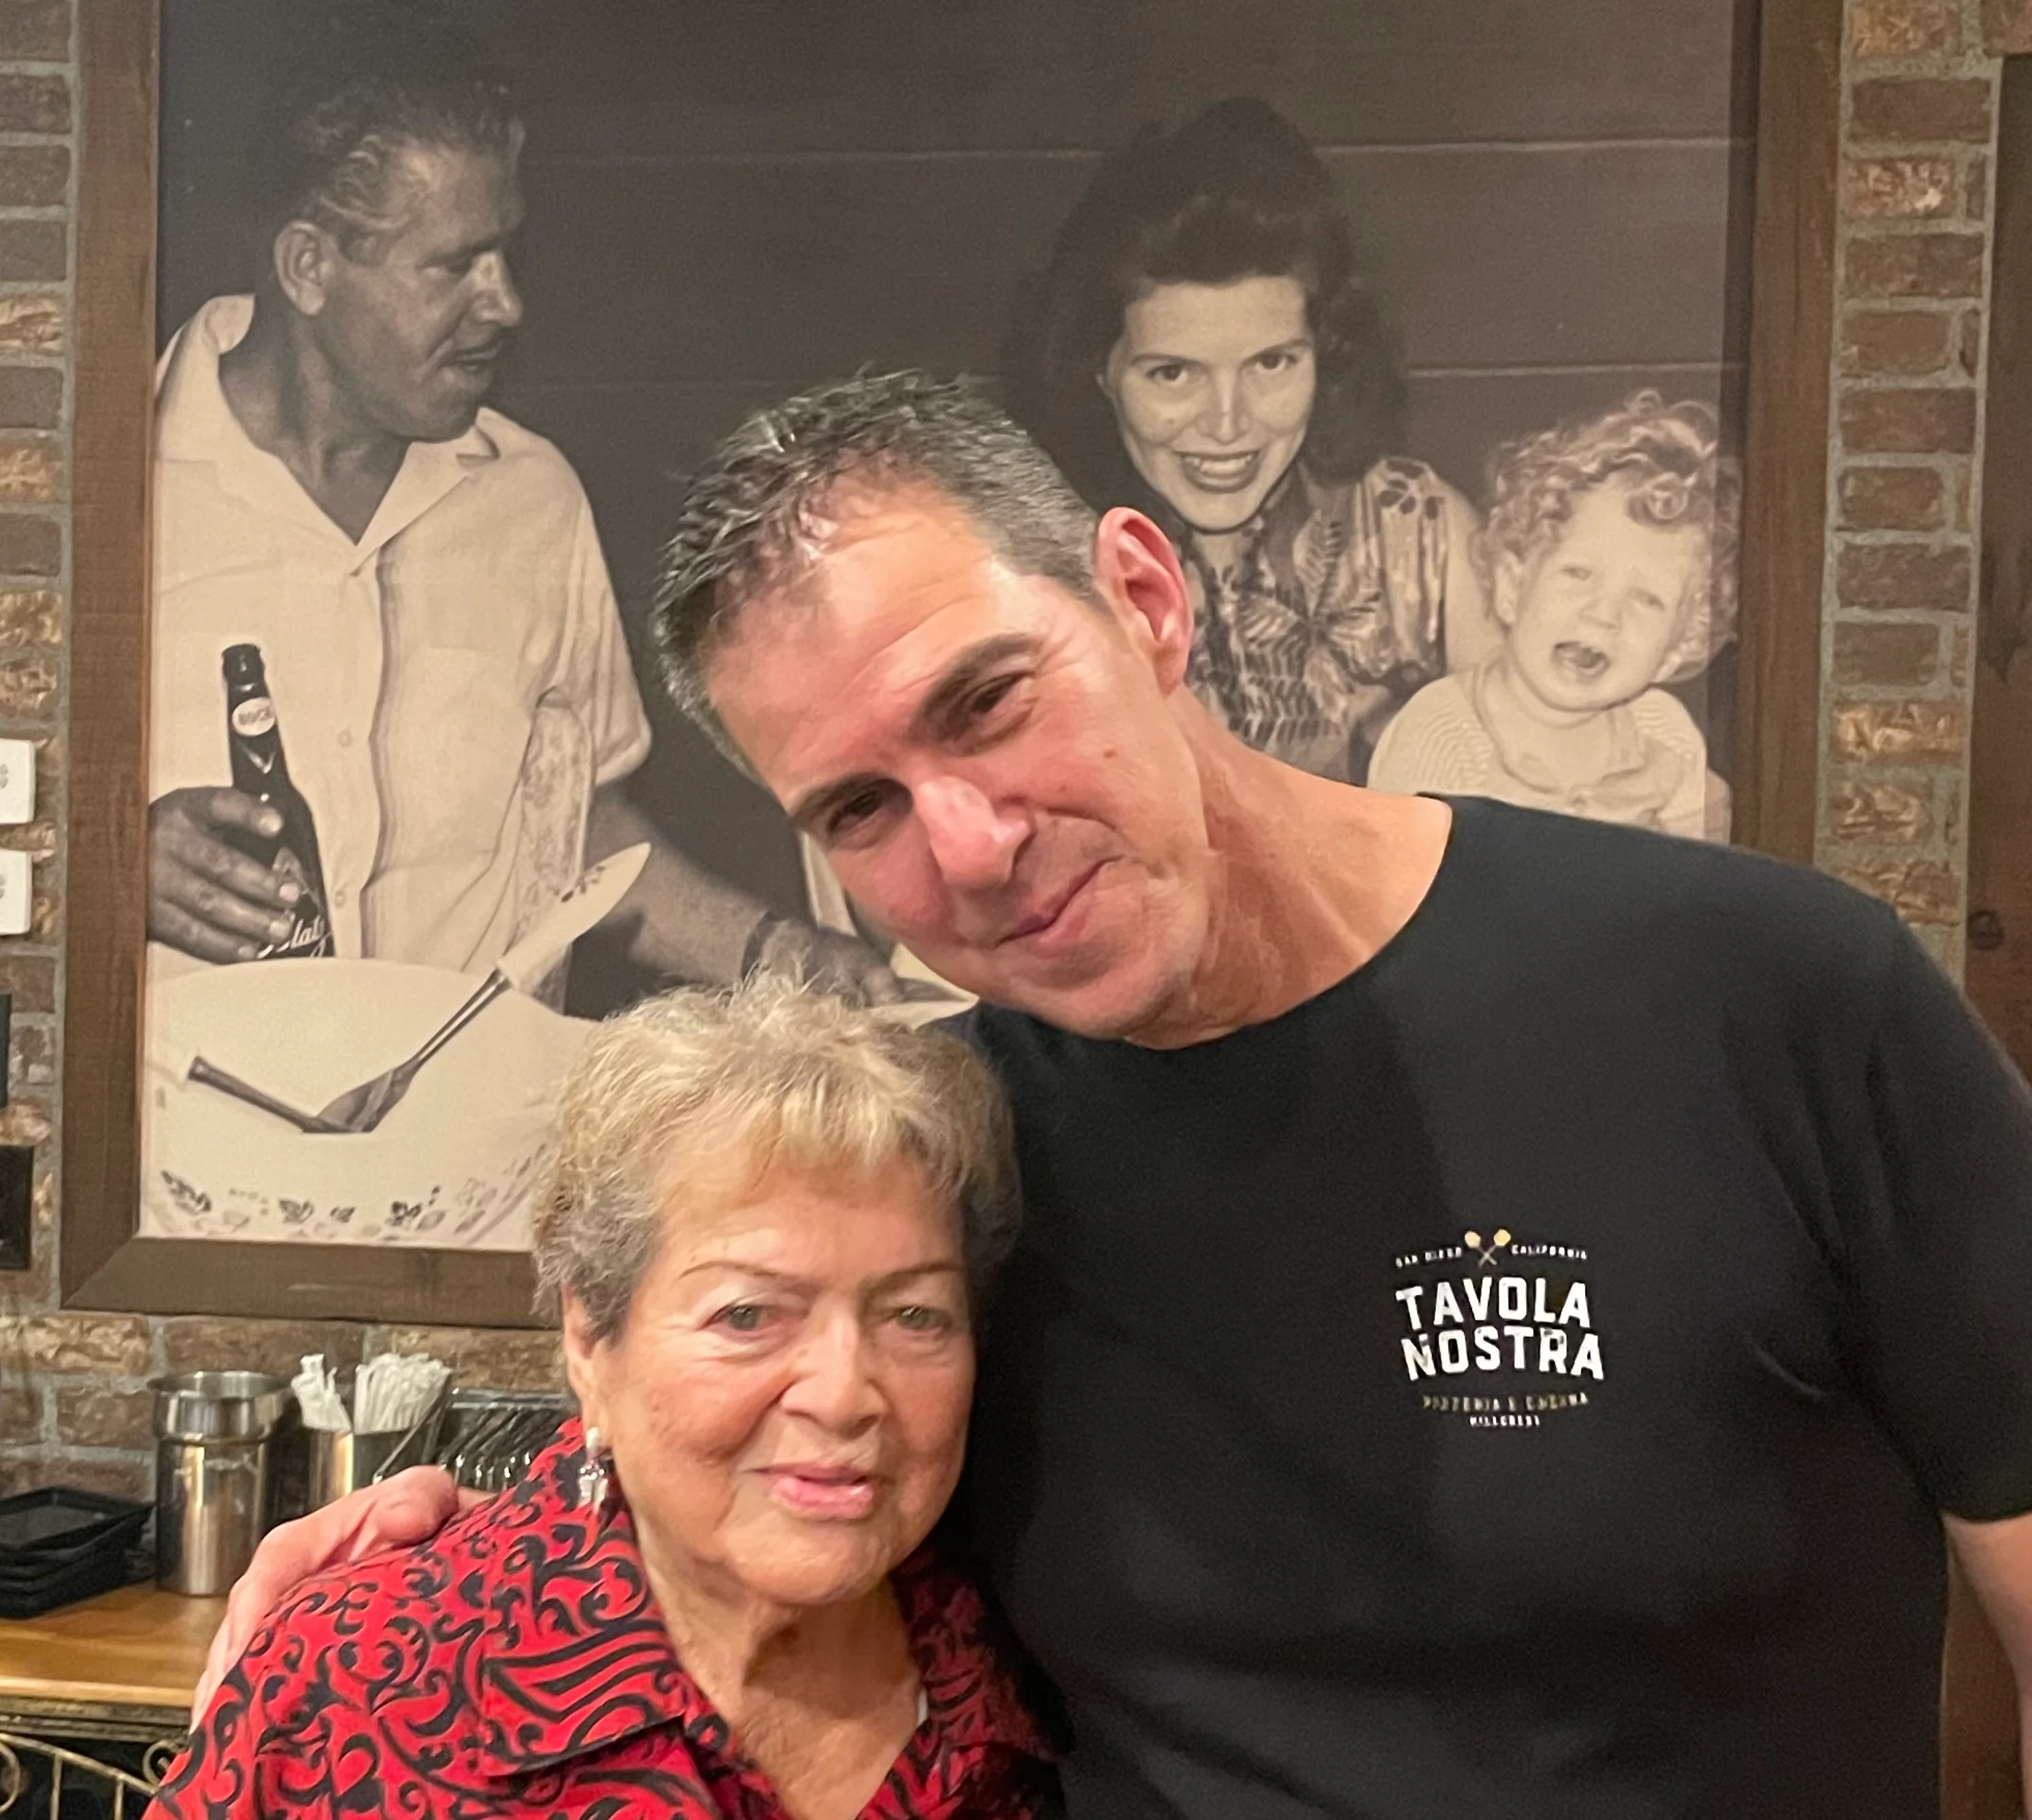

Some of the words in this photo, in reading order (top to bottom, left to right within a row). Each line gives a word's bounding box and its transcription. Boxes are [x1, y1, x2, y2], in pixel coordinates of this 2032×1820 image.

[1510, 1244, 1588, 1260] CALIFORNIA
[1395, 1276, 1591, 1330] TAVOLA
[1401, 1326, 1605, 1381] NOSTRA
[1422, 1395, 1501, 1412] PIZZERIA
[1469, 1415, 1540, 1428] HILLCREST
